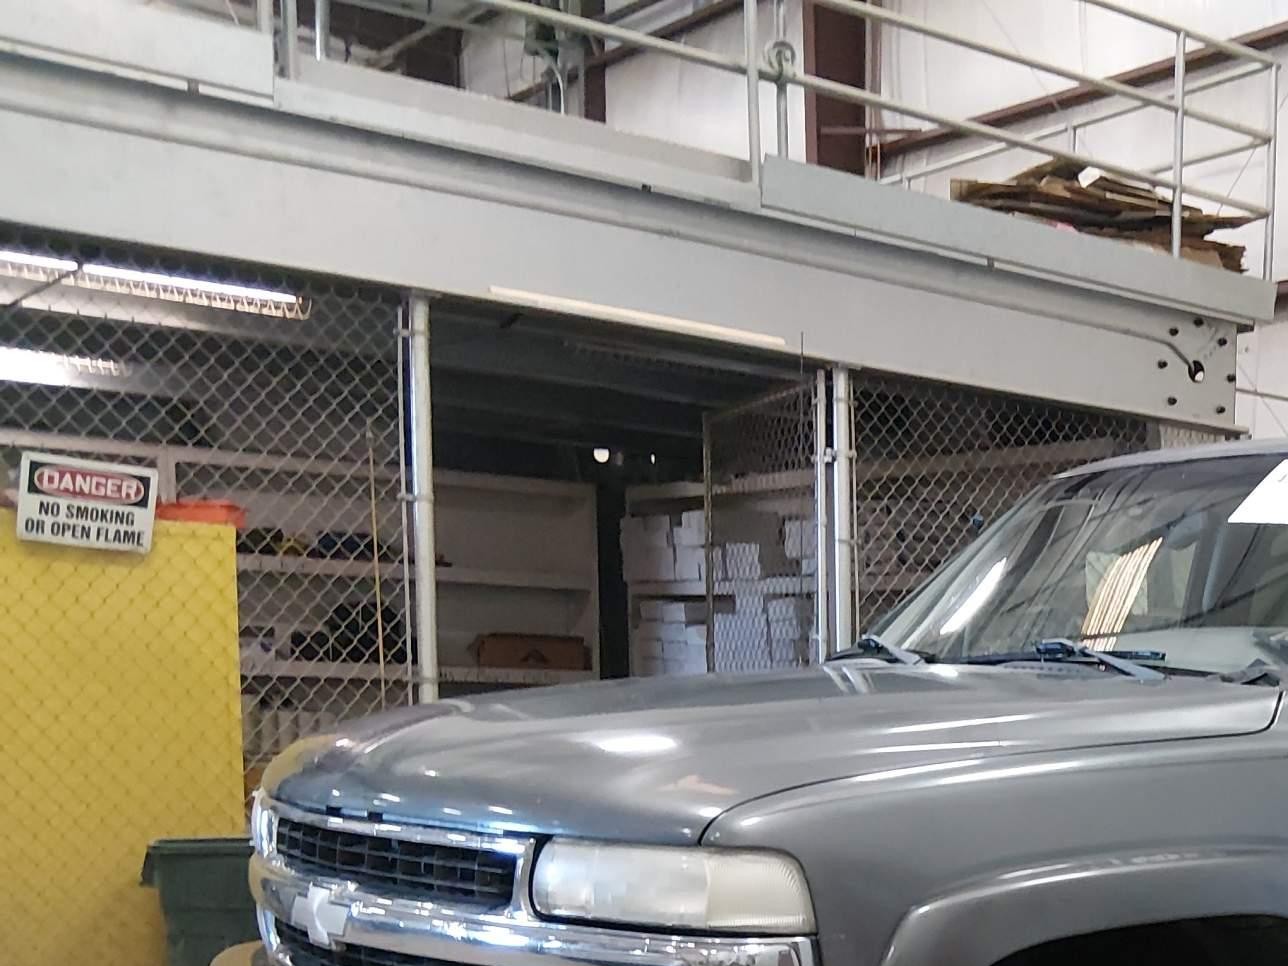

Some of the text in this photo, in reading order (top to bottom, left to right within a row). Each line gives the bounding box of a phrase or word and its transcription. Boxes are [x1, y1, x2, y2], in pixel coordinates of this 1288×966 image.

[42, 468, 138, 500] DANGER
[38, 501, 135, 526] NO SMOKING
[25, 518, 145, 547] OR OPEN FLAME
